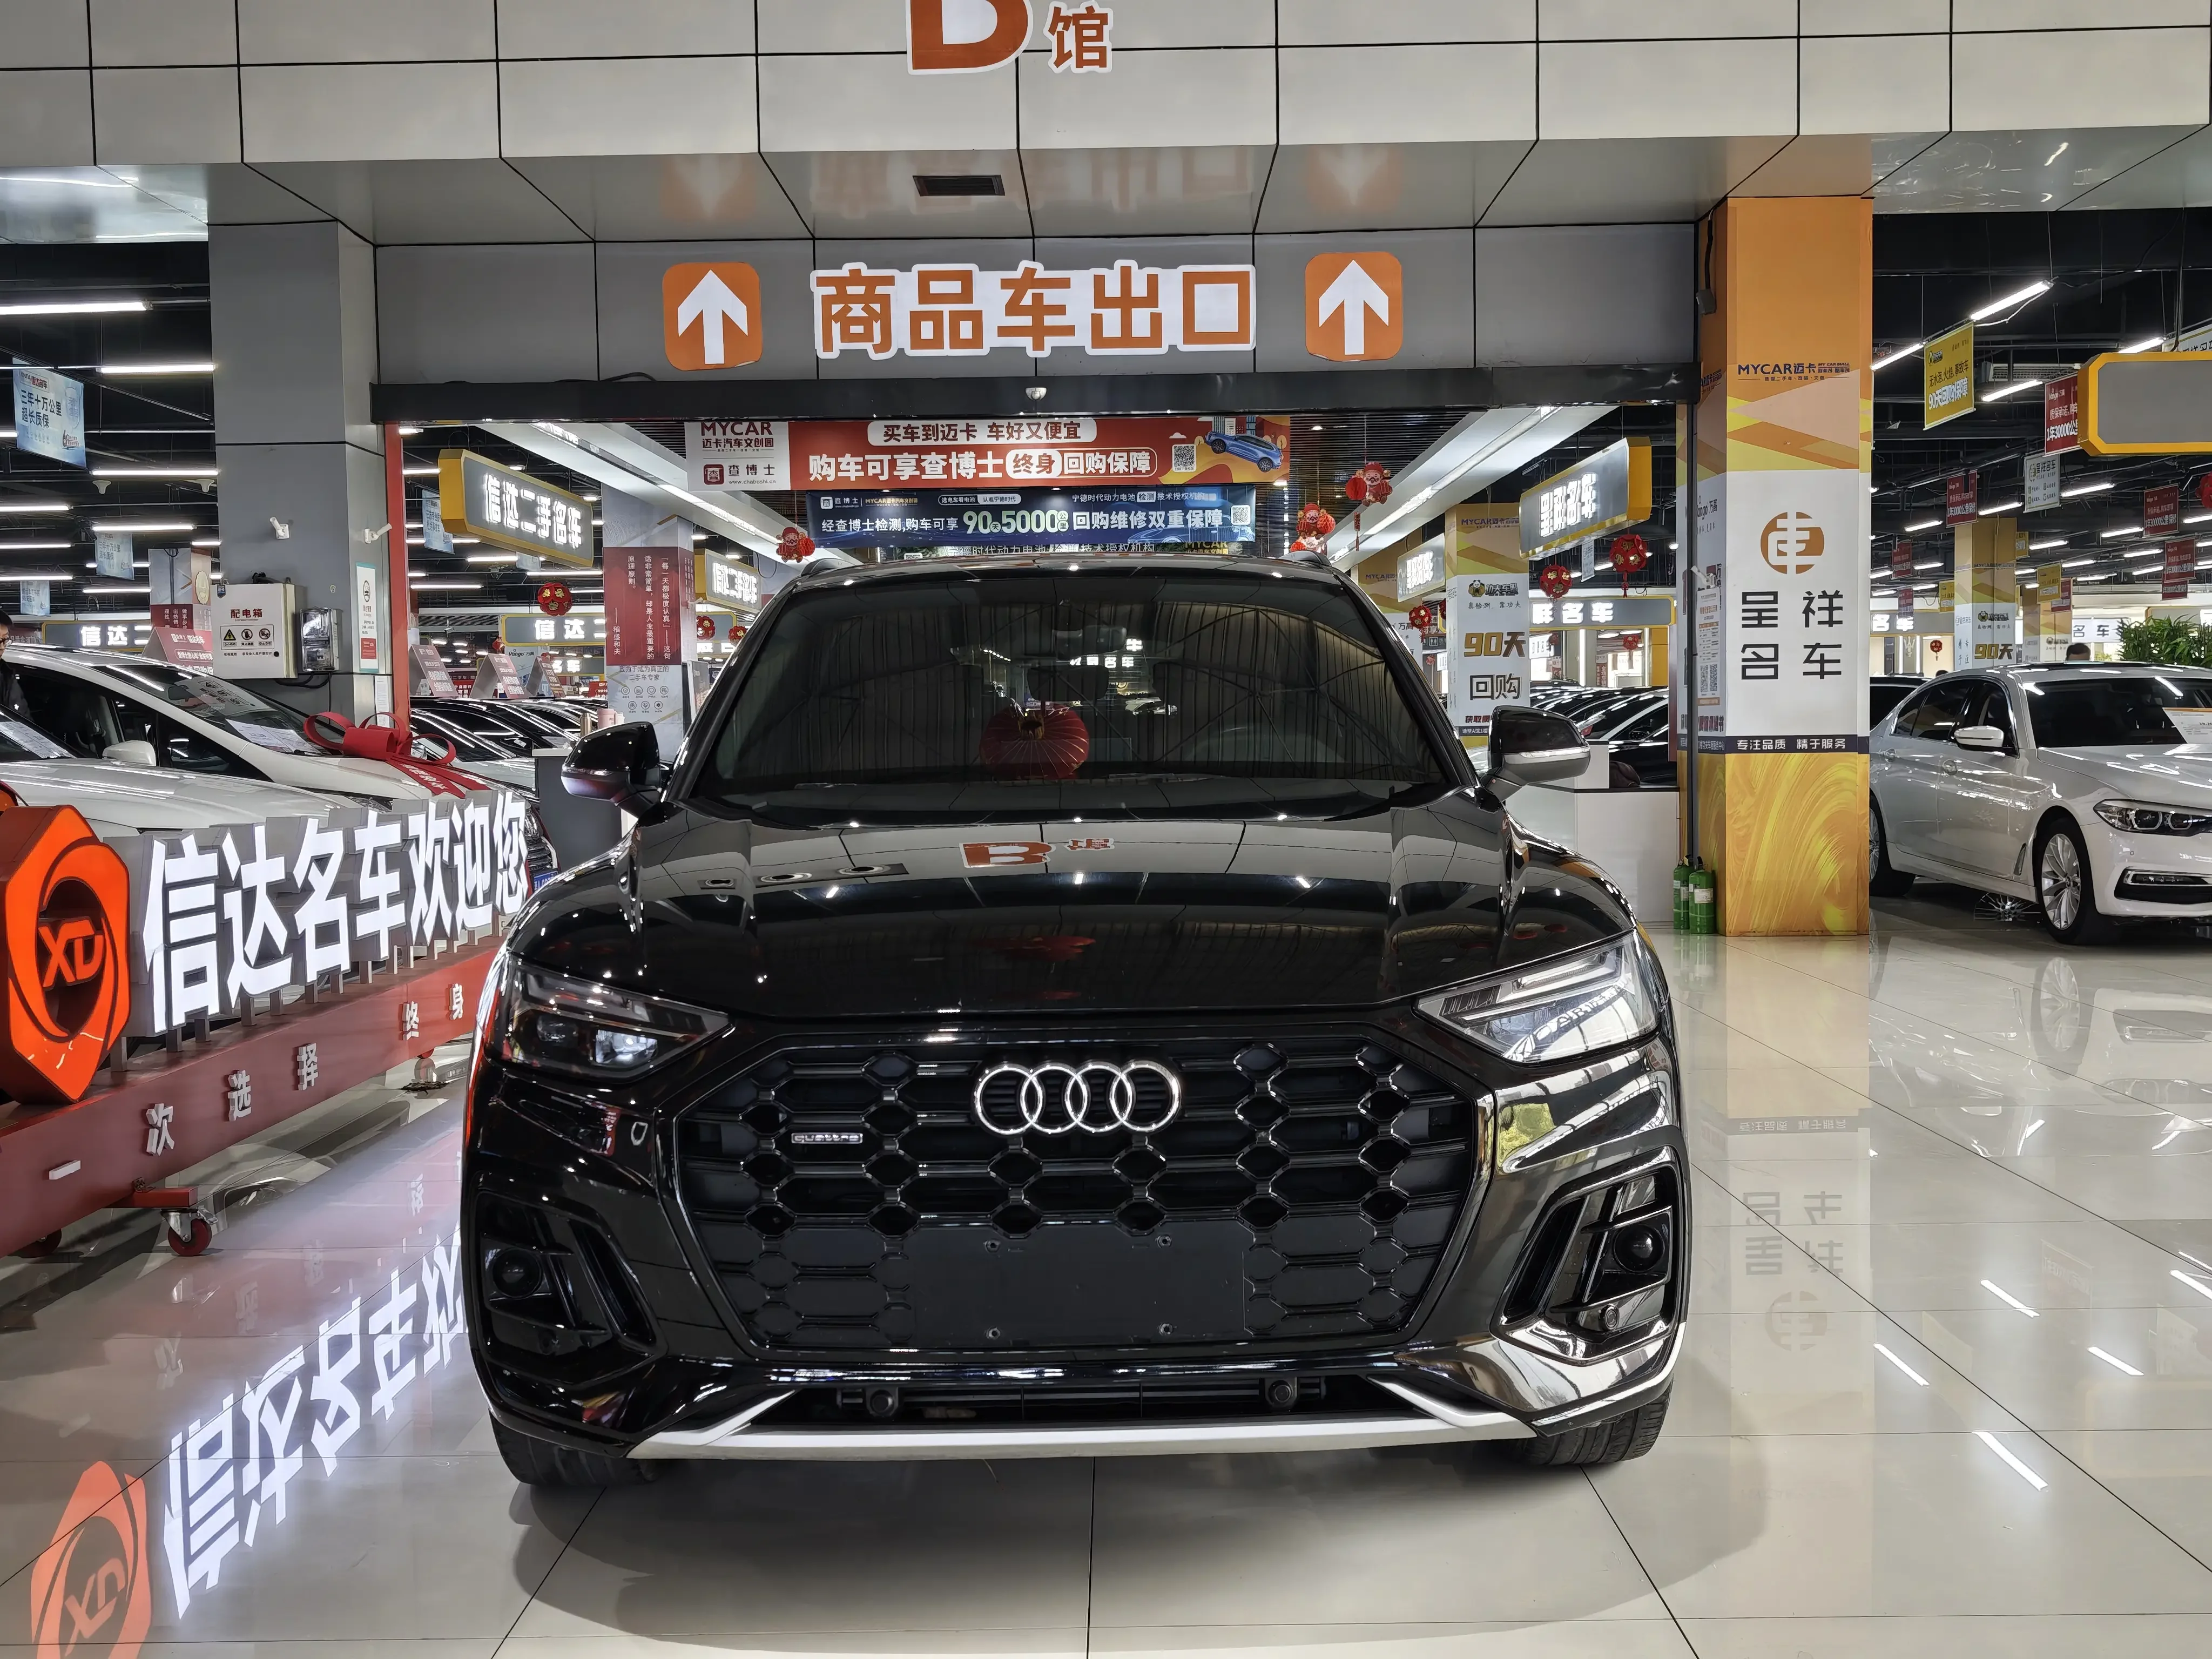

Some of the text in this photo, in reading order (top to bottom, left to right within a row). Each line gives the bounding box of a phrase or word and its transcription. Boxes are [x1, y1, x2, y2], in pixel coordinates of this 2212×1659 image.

[815, 265, 1251, 354] 商品车出口
[21, 389, 62, 417] 三年十万公里
[1928, 376, 1969, 410] 90天回购保障
[22, 406, 50, 429] 超长质保
[700, 421, 773, 436] MYCAR
[882, 421, 1081, 442] 买车到迈卡 车好又便宜
[702, 438, 774, 449] 迈卡汽车文创园
[728, 464, 775, 476] 查博士
[808, 451, 1152, 482] 购车可享查博士 终身 回购保障
[1071, 494, 1136, 503] 宁德时代动力电池
[1138, 492, 1156, 502] 检测
[1539, 473, 1597, 538] 呈祥名车
[484, 473, 582, 550] 信达二手名车
[1072, 509, 1223, 530] 回购维修双重保障
[230, 608, 263, 619] 配电箱
[1741, 589, 1844, 629] 呈祥
[1872, 613, 1914, 631] 名车
[2073, 625, 2110, 638] 名车
[1464, 631, 1526, 657] 90天
[1974, 643, 2013, 660] 90天
[619, 665, 669, 673] 致力于成为真正的
[1741, 643, 1843, 680] 名车
[1469, 673, 1521, 700] 回购
[1737, 738, 1845, 750] 专注品质 精于服务
[144, 790, 529, 1034] 信达名车欢迎您
